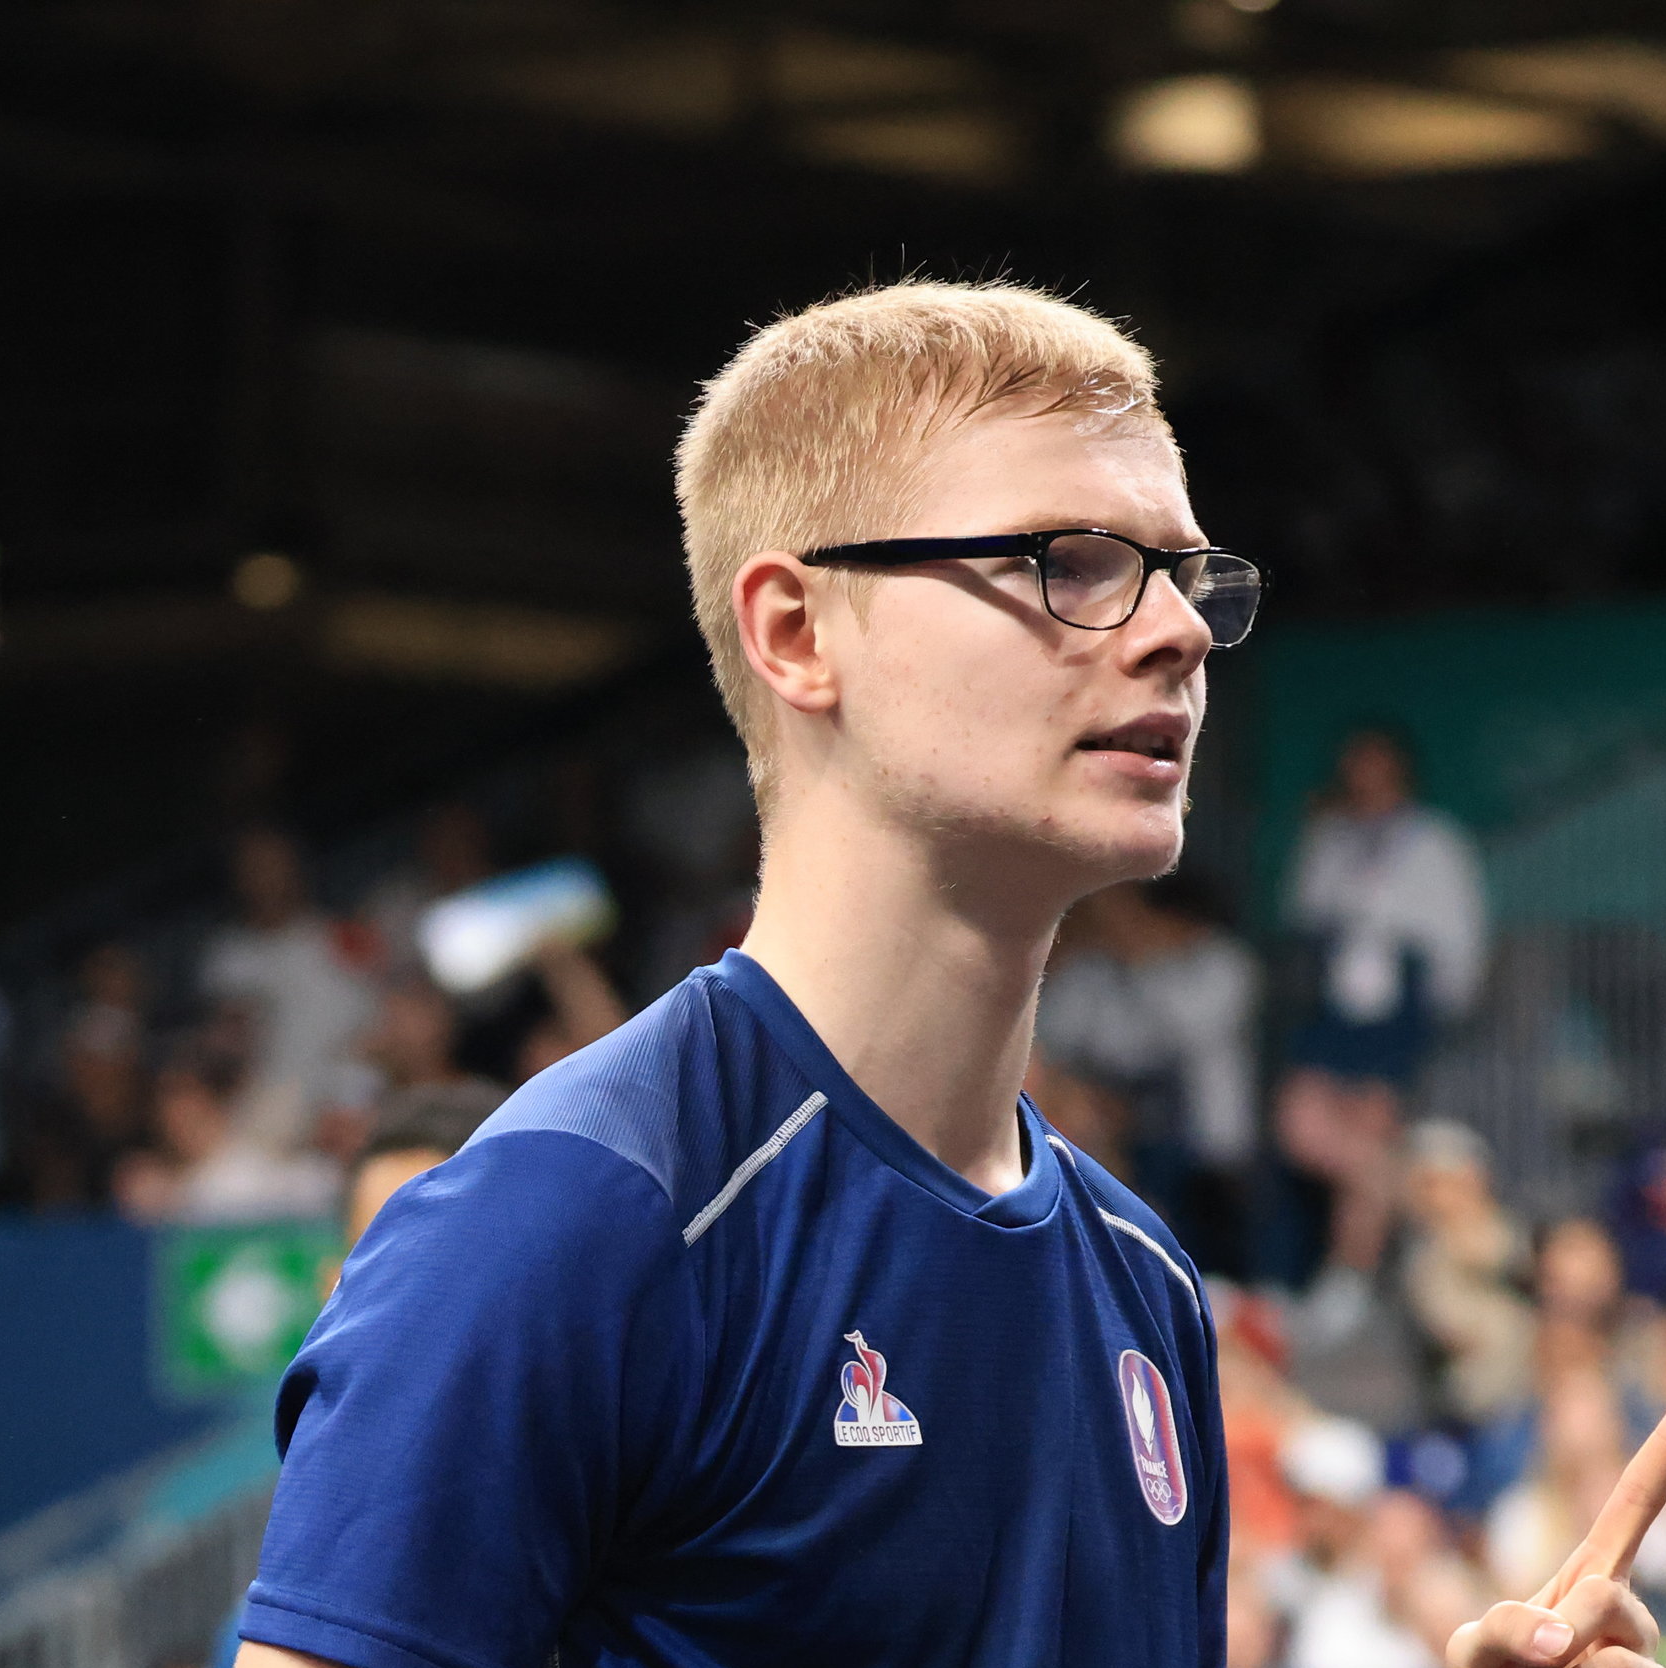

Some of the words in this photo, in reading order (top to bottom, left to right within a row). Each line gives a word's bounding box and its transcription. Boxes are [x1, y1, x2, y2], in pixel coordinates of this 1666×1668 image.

[836, 1425, 849, 1442] LE
[849, 1425, 871, 1443] COQ
[871, 1424, 917, 1443] SPORTIF
[1139, 1453, 1169, 1479] FRANCE
